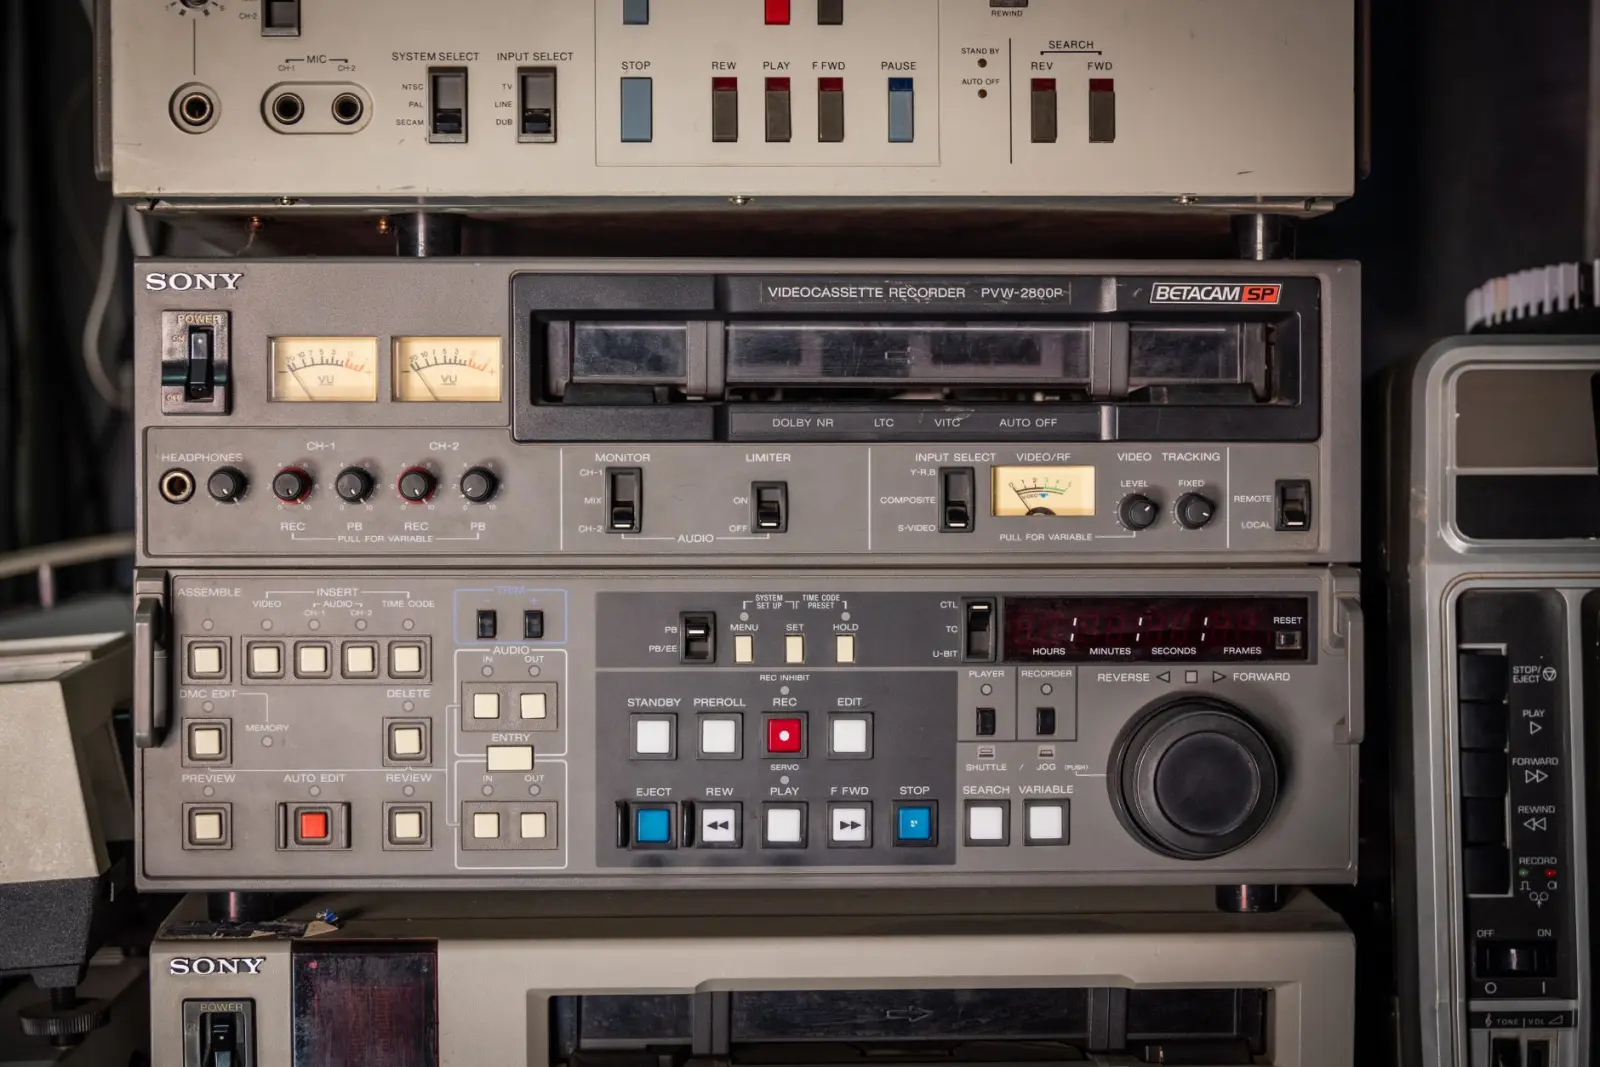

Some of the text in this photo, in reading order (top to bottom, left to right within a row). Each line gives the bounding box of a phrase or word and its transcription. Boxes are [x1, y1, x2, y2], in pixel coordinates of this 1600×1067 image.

[1048, 41, 1094, 50] SEARCH
[306, 55, 327, 64] MIC
[392, 52, 480, 62] SYSTEM SELECT
[497, 52, 574, 62] INPUT SELECT
[621, 61, 651, 71] STOP
[712, 61, 736, 70] REW
[763, 61, 790, 70] PLAY
[812, 61, 846, 70] F FWD
[881, 61, 916, 70] PAUSE
[1031, 62, 1054, 70] REV
[1088, 62, 1113, 70] FWD
[146, 273, 243, 290] SONY
[768, 286, 1062, 298] VIDEOCASSETTE RECORDER PVW-2800P
[1156, 285, 1275, 301] BETACAM SP
[177, 314, 222, 324] POWER
[773, 418, 834, 428] DOLBY NR
[874, 418, 894, 428] LTC
[934, 418, 960, 428] VITC
[1000, 418, 1058, 428] AUTO OFF
[307, 442, 336, 450] CH-1
[430, 442, 460, 450] CH-2
[162, 453, 244, 462] HEADPHONES
[595, 453, 650, 462] MONITOR
[746, 453, 791, 462] LIMITER
[916, 453, 996, 462] INPUT SELECT
[1016, 453, 1072, 462] VIDEO/RF
[1118, 452, 1220, 462] VIDEO TRACKING
[280, 522, 306, 531] REC
[347, 522, 363, 531] PB
[404, 522, 429, 531] REC
[470, 522, 486, 531] PB
[677, 534, 714, 542] AUDIO
[1000, 534, 1092, 542] PULL FOR VARIABLE
[178, 588, 242, 597] ASSEMBLE
[316, 588, 359, 597] INSERT
[252, 600, 282, 608] VIDEO
[323, 600, 353, 608] AUDIO
[382, 600, 435, 608] TIME CODE
[1273, 616, 1303, 624] RESET
[665, 626, 678, 634] PB
[730, 624, 759, 632] MENU
[786, 624, 804, 632] SET
[833, 624, 859, 632] HOLD
[493, 646, 530, 654] AUDIO
[648, 645, 678, 653] PB/EE
[1032, 648, 1066, 656] HOURS
[1089, 648, 1132, 656] MINUTES
[1151, 648, 1197, 656] SECONDS
[1224, 647, 1262, 655] FRAMES
[1512, 666, 1542, 674] STOP/
[1097, 673, 1150, 682] REVERSE
[1233, 673, 1290, 682] FORWARD
[1512, 675, 1541, 684] EJECT
[179, 690, 238, 698] DMC EDIT
[386, 690, 431, 698] DELETE
[627, 698, 682, 708] STANDBY
[693, 698, 746, 708] PREROLL
[772, 698, 798, 706] REC
[837, 698, 862, 706] EDIT
[1522, 710, 1546, 718] PLAY
[491, 733, 531, 742] ENTRY
[1512, 758, 1559, 766] FORWARD
[182, 774, 236, 783] PREVIEW
[284, 774, 347, 783] AUTO EDIT
[386, 774, 432, 783] REVIEW
[636, 788, 672, 797] EJECT
[706, 787, 734, 796] REW
[770, 787, 800, 796] PLAY
[830, 787, 869, 796] F FWD
[900, 786, 930, 796] STOP
[962, 786, 1010, 794] SEARCH
[1018, 785, 1074, 794] VARIABLE
[1518, 805, 1556, 814] REWIND
[1518, 857, 1558, 865] RECORD
[1476, 929, 1494, 938] OFF
[1537, 928, 1552, 938] ON
[170, 958, 264, 975] SONY
[200, 1003, 244, 1012] POWER
